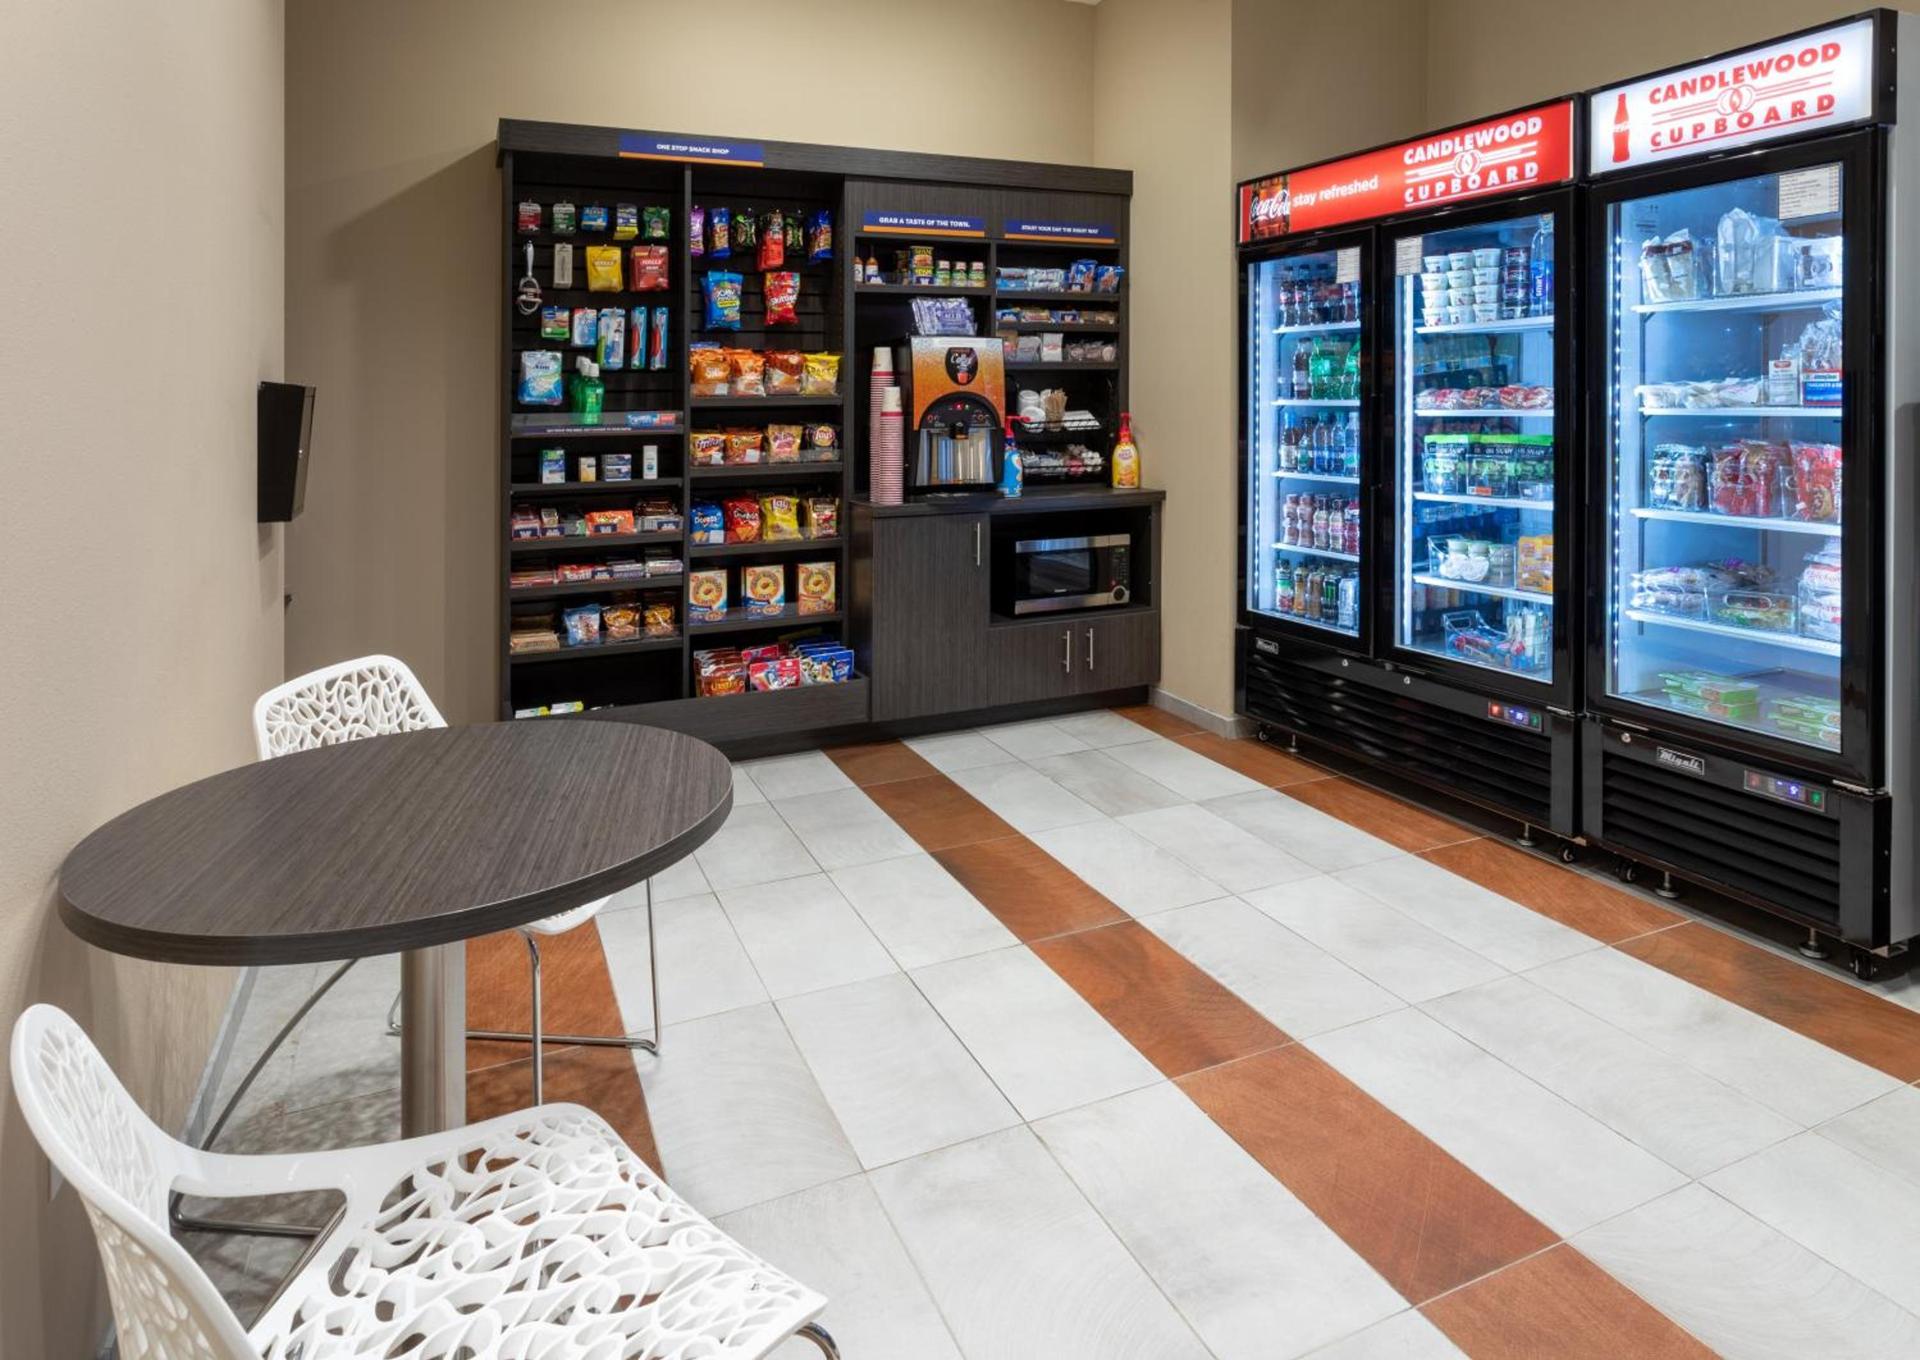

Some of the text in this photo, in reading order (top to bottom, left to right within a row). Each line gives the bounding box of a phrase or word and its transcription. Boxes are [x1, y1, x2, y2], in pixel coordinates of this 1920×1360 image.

[1648, 42, 1841, 105] CANDLEWOOD
[1650, 94, 1836, 147] CUPBOARD
[656, 143, 671, 151] ONE
[1403, 116, 1543, 165] CANDLEWOOD
[1293, 175, 1379, 208] stay refreshed
[1404, 162, 1539, 203] CUPBOARD
[950, 220, 971, 228] TOWN.
[1250, 188, 1291, 224] Coca-Cola
